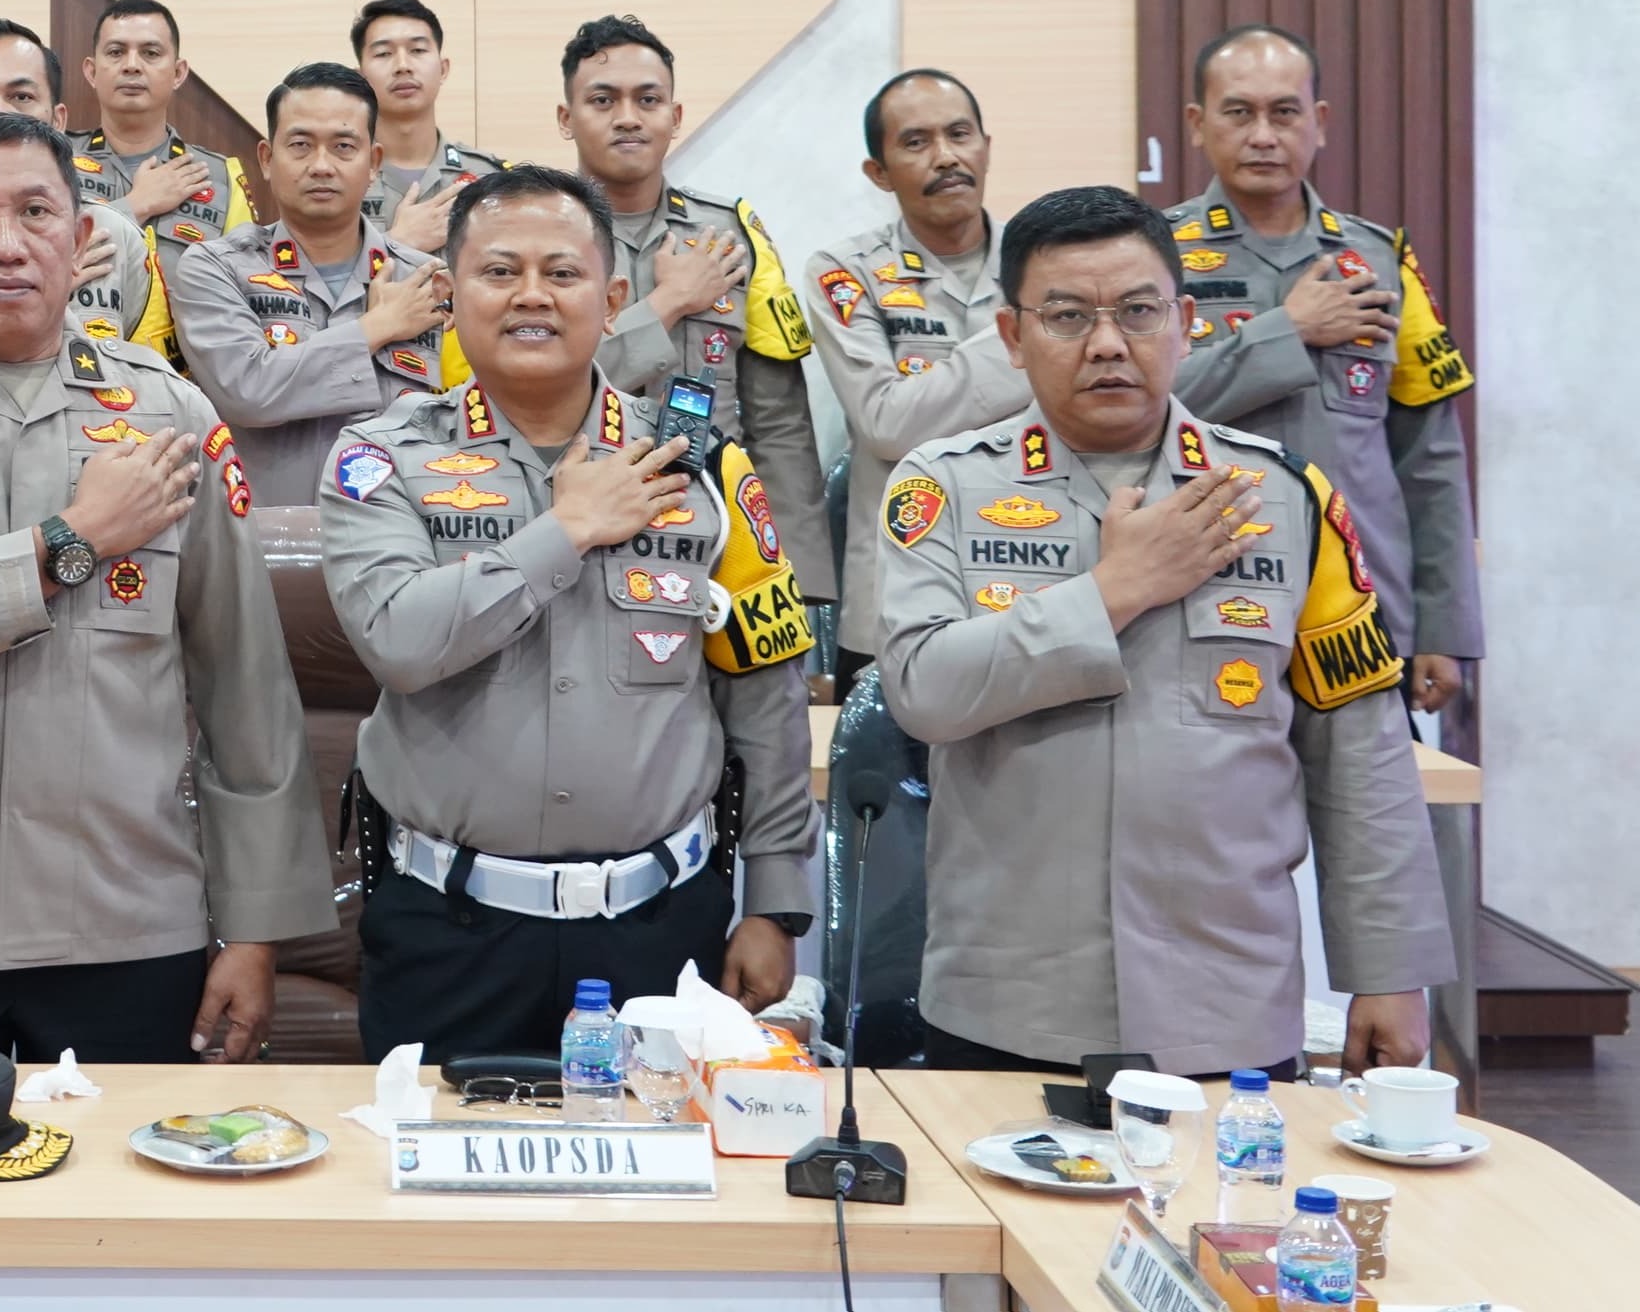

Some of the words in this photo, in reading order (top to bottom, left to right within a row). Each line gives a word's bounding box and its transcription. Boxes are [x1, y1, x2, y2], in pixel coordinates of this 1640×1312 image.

[180, 202, 218, 223] OLRI
[69, 288, 122, 313] OLRI
[971, 539, 1070, 567] HENKY
[1215, 556, 1285, 583] OLRI
[755, 624, 800, 660] OMP
[463, 1136, 640, 1175] KAOPSDA
